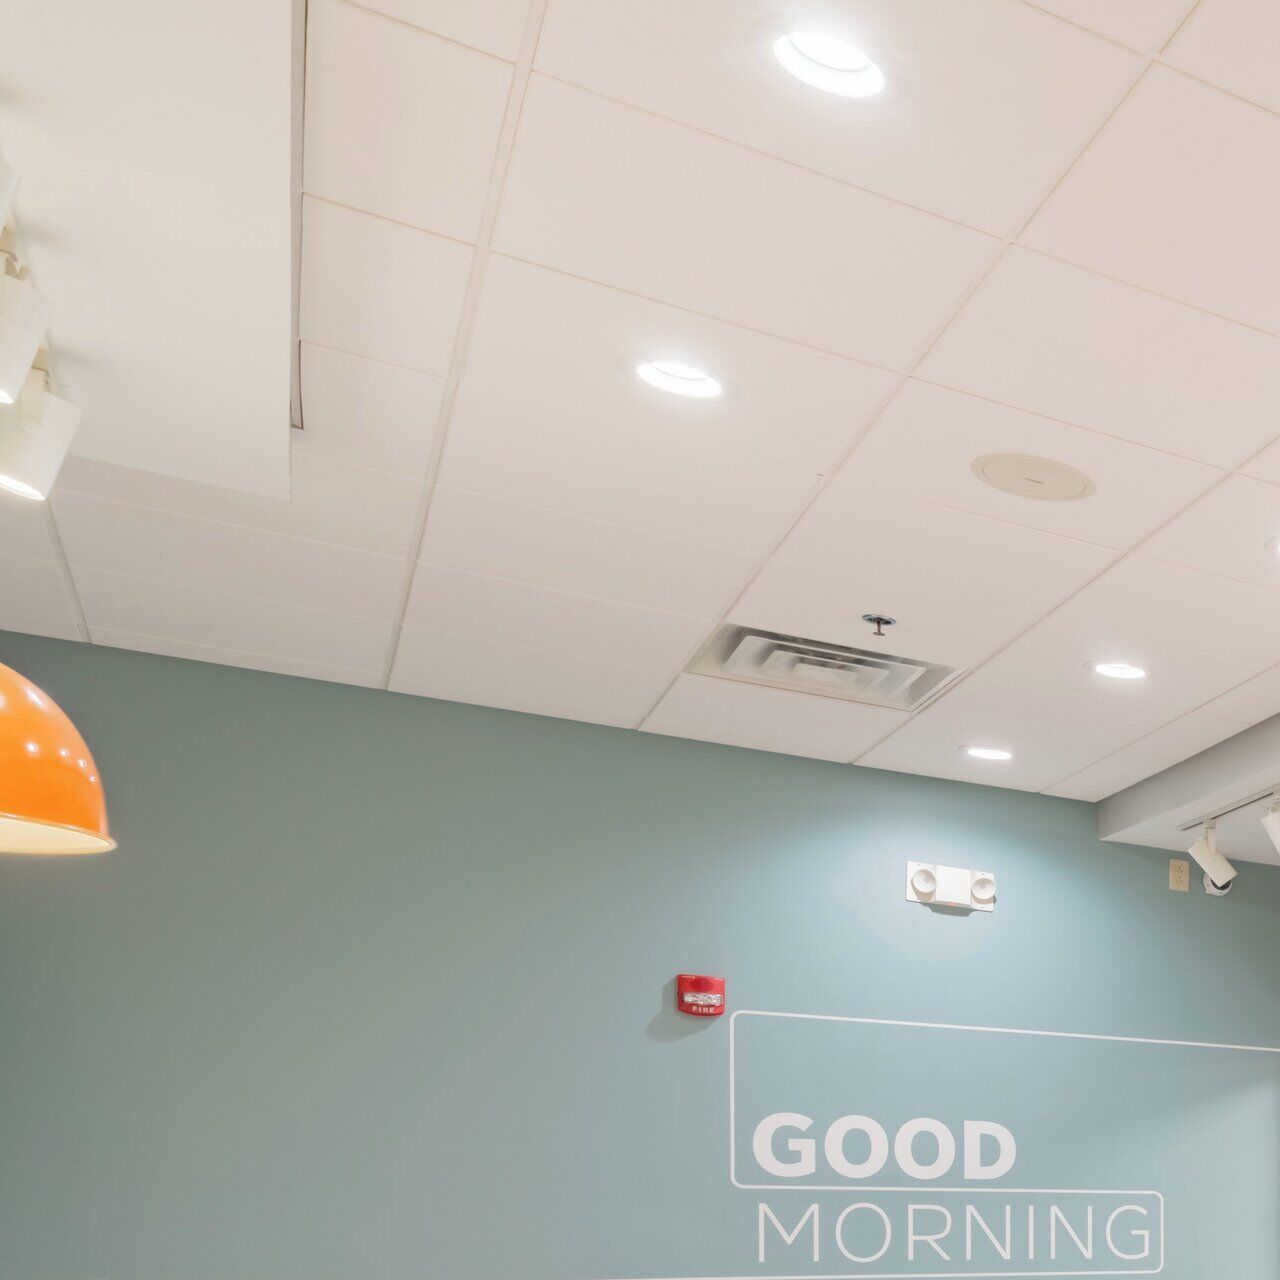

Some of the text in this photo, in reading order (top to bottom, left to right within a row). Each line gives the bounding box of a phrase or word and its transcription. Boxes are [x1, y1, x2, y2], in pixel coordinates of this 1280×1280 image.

[692, 1005, 715, 1013] FIRE
[752, 1111, 1017, 1180] GOOD
[758, 1202, 1150, 1263] MORNING
